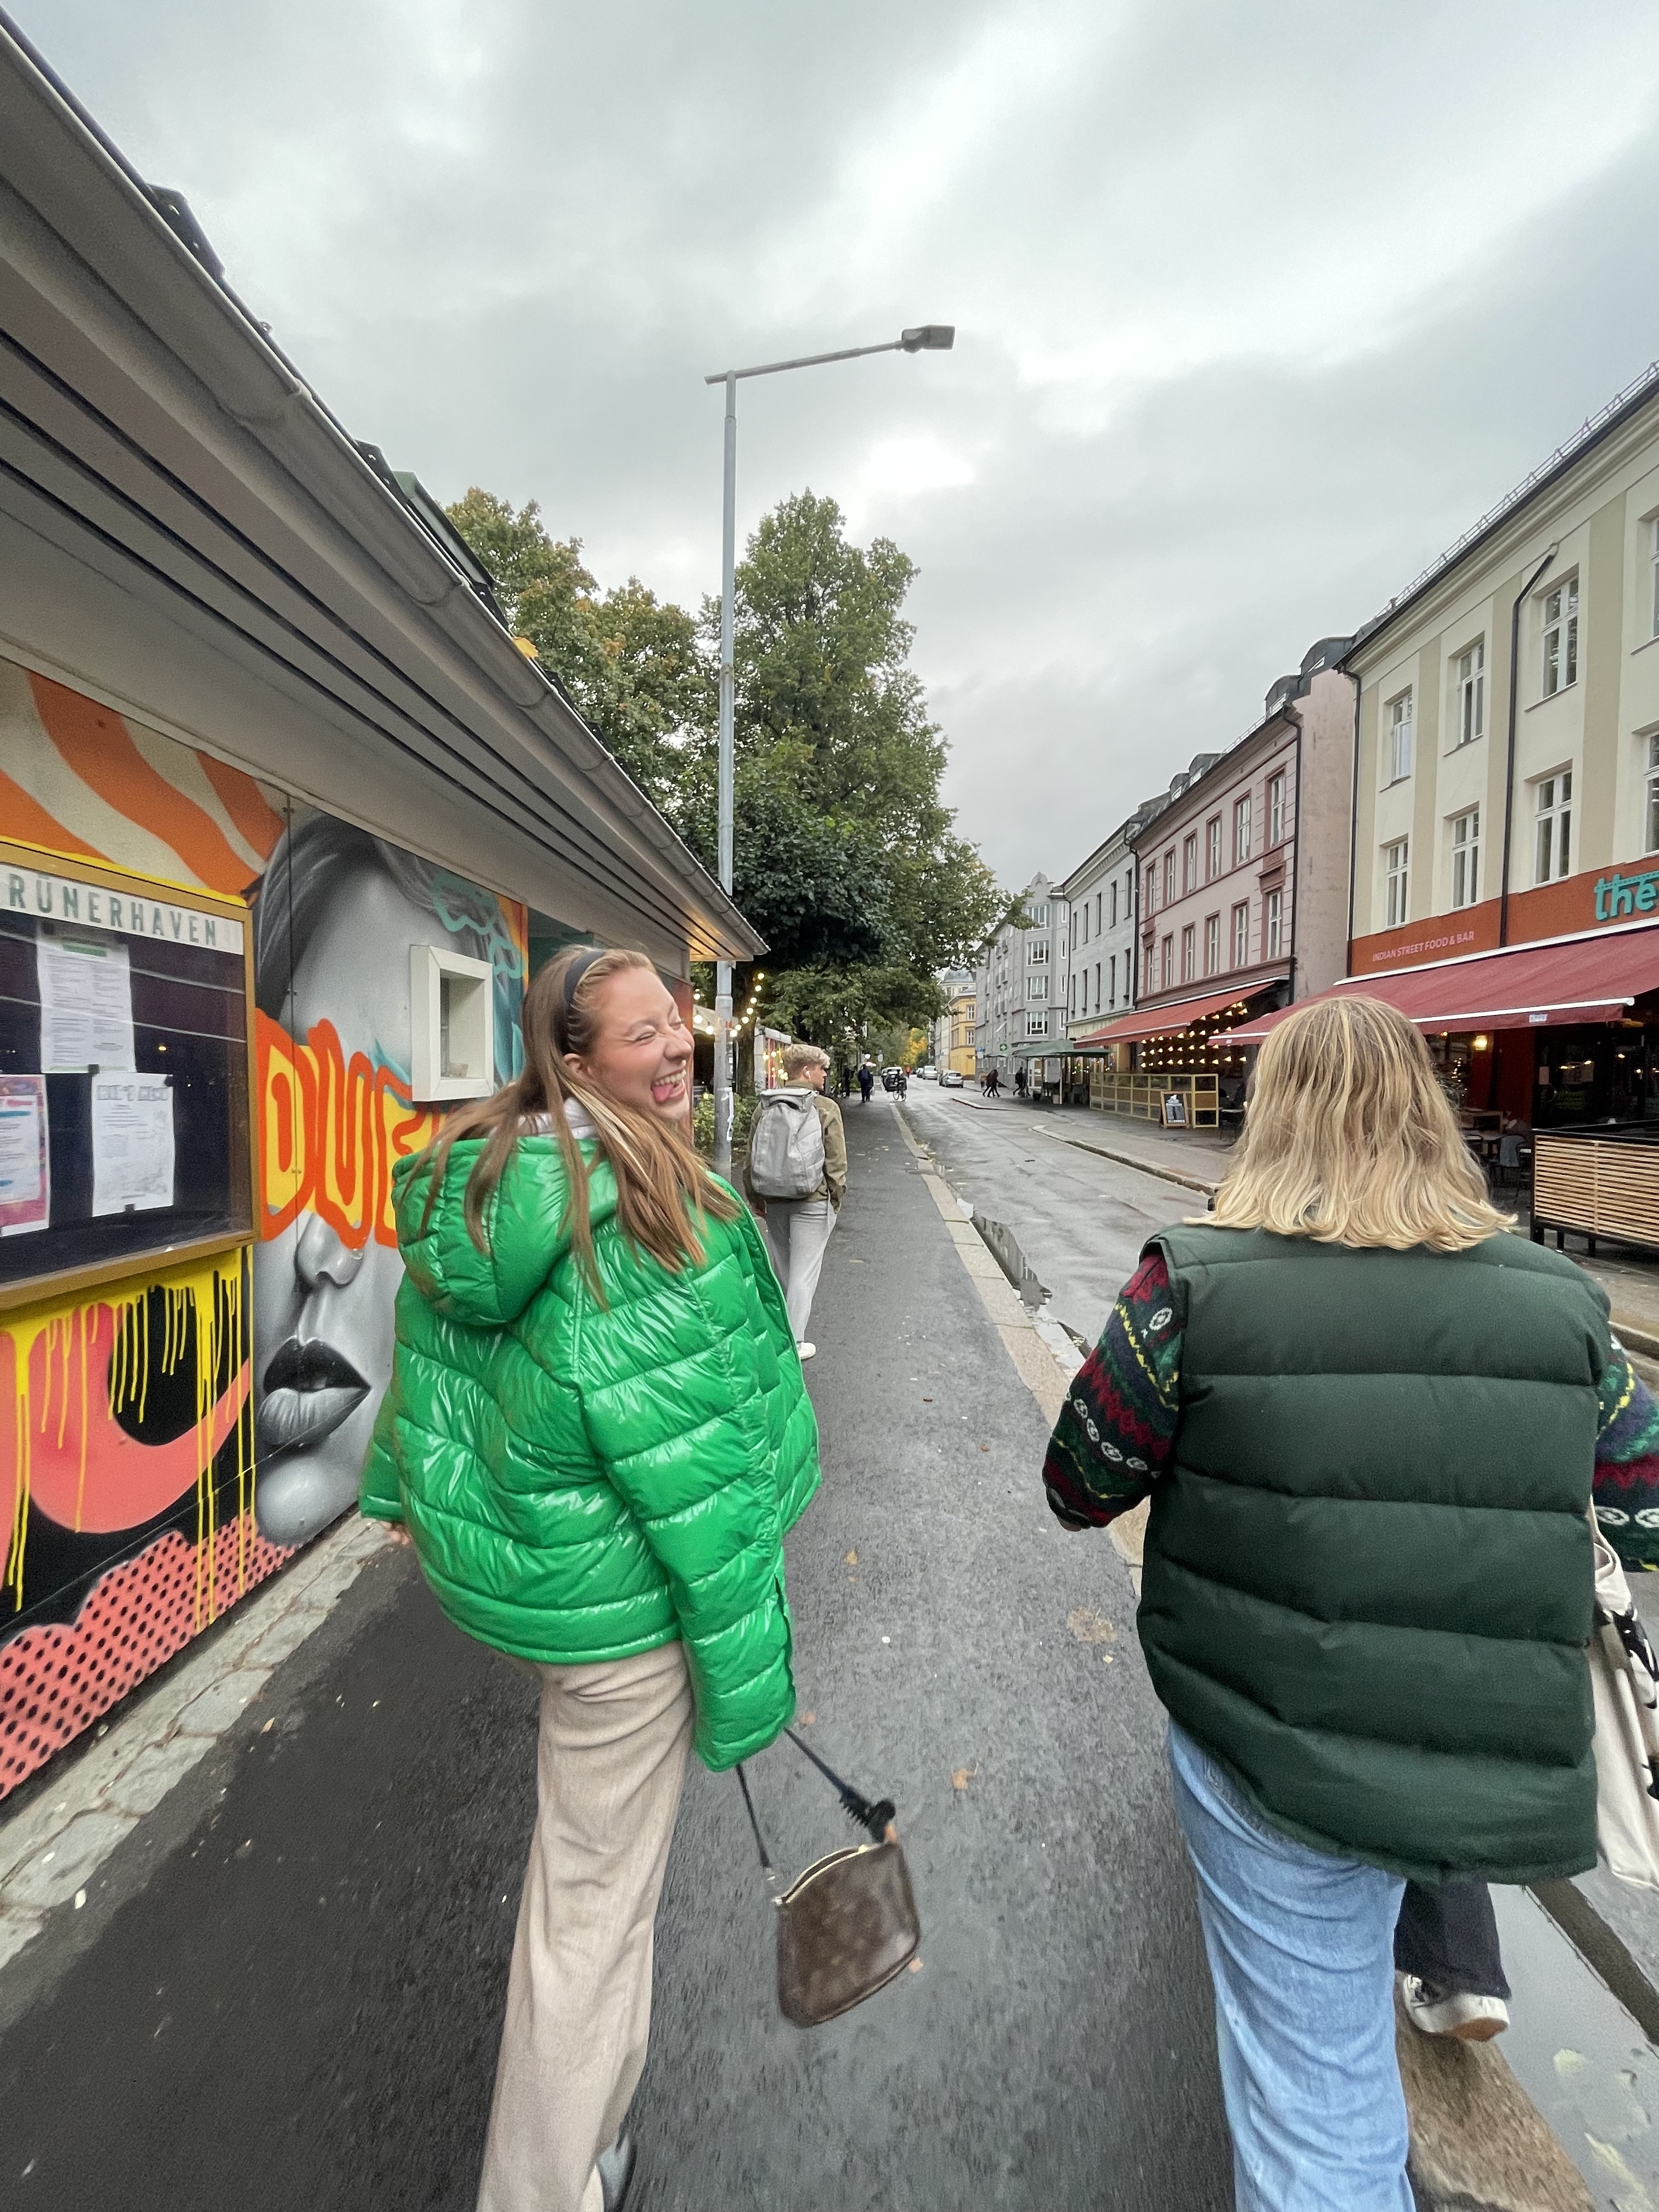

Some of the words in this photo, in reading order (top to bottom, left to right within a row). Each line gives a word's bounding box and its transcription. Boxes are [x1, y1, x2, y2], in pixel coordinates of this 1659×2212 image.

[1373, 949, 1396, 962] INDIAN
[1397, 943, 1424, 957] STREET
[1425, 937, 1448, 950] FOOD
[1449, 935, 1455, 945] &
[1457, 931, 1475, 944] BAR
